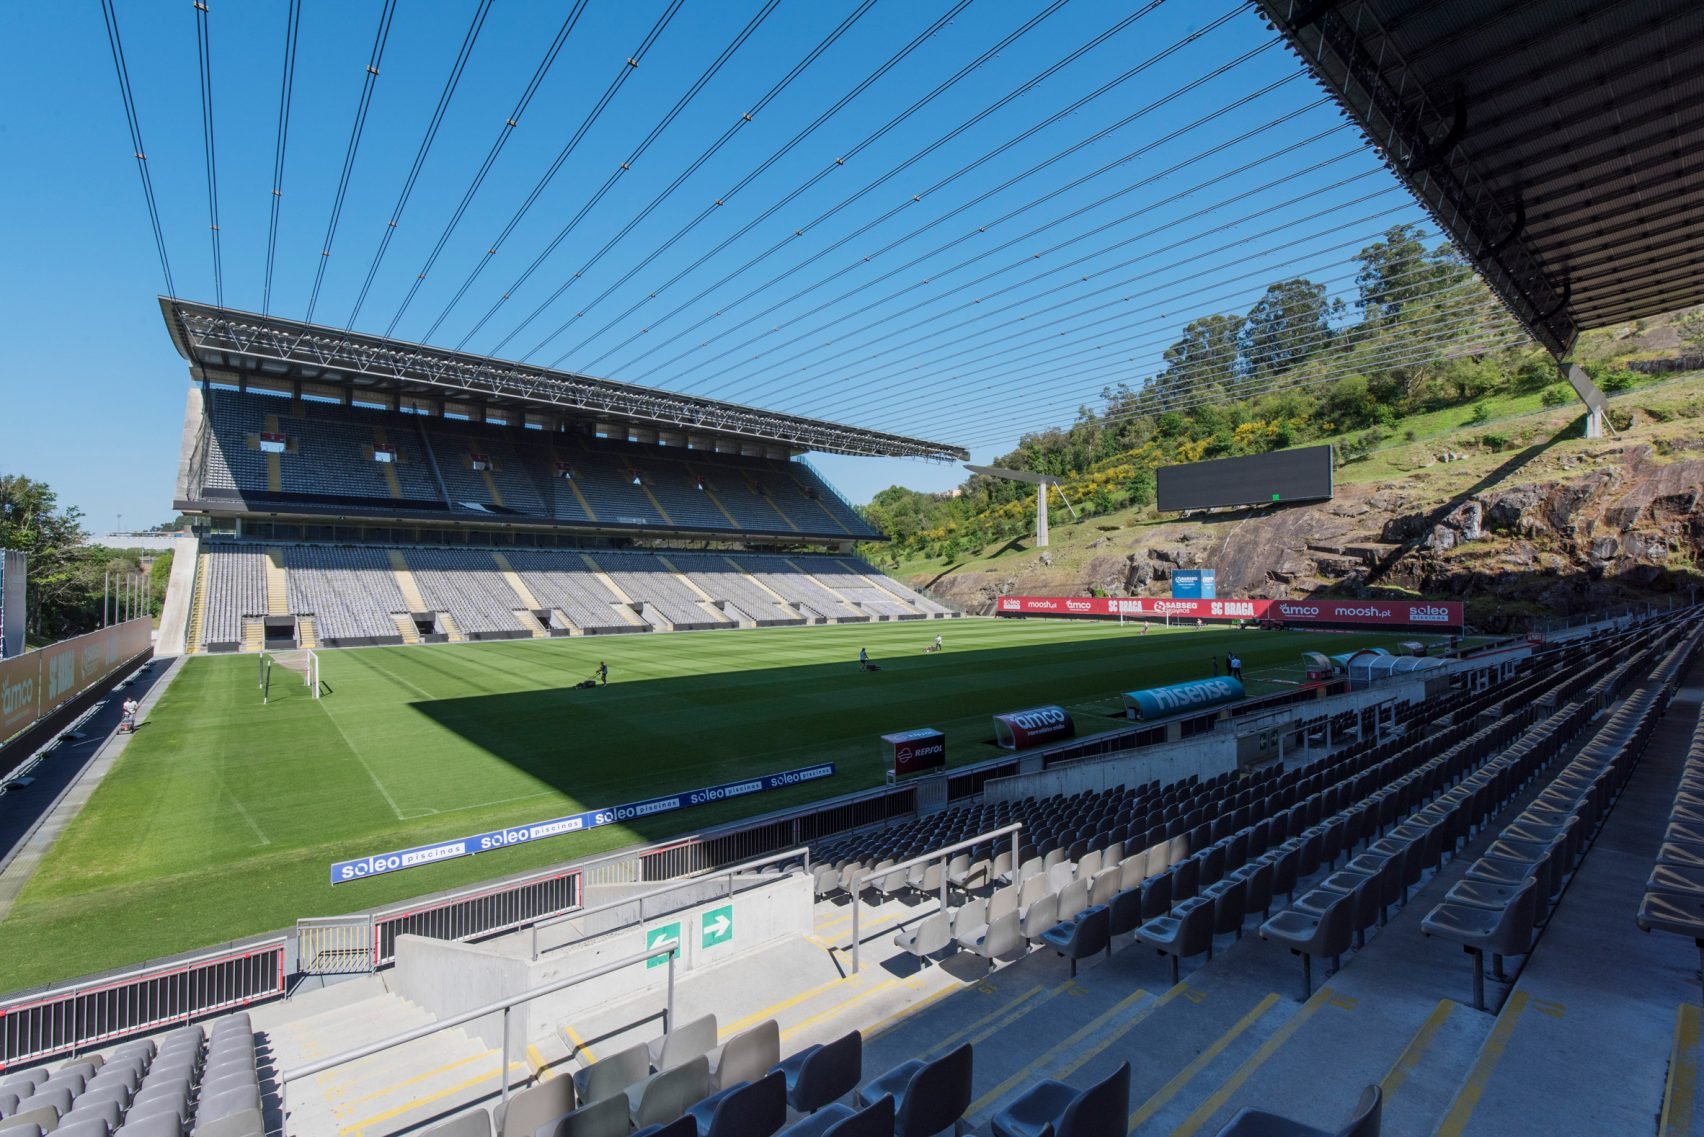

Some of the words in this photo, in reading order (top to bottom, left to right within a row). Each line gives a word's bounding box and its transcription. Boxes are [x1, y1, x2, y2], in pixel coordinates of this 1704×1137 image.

[1211, 602, 1222, 615] SC
[1224, 602, 1254, 616] BRAGA
[1281, 603, 1319, 615] amco
[1335, 606, 1392, 618] moosh.pt
[1409, 605, 1449, 615] soleo
[1151, 680, 1232, 710] Hisense
[1013, 709, 1065, 730] amco
[915, 744, 943, 757] REPSOL
[771, 772, 800, 787] soleo
[690, 788, 724, 804] soleo
[595, 807, 635, 825] soleo
[481, 829, 529, 849] soleo
[342, 857, 400, 879] soleo
